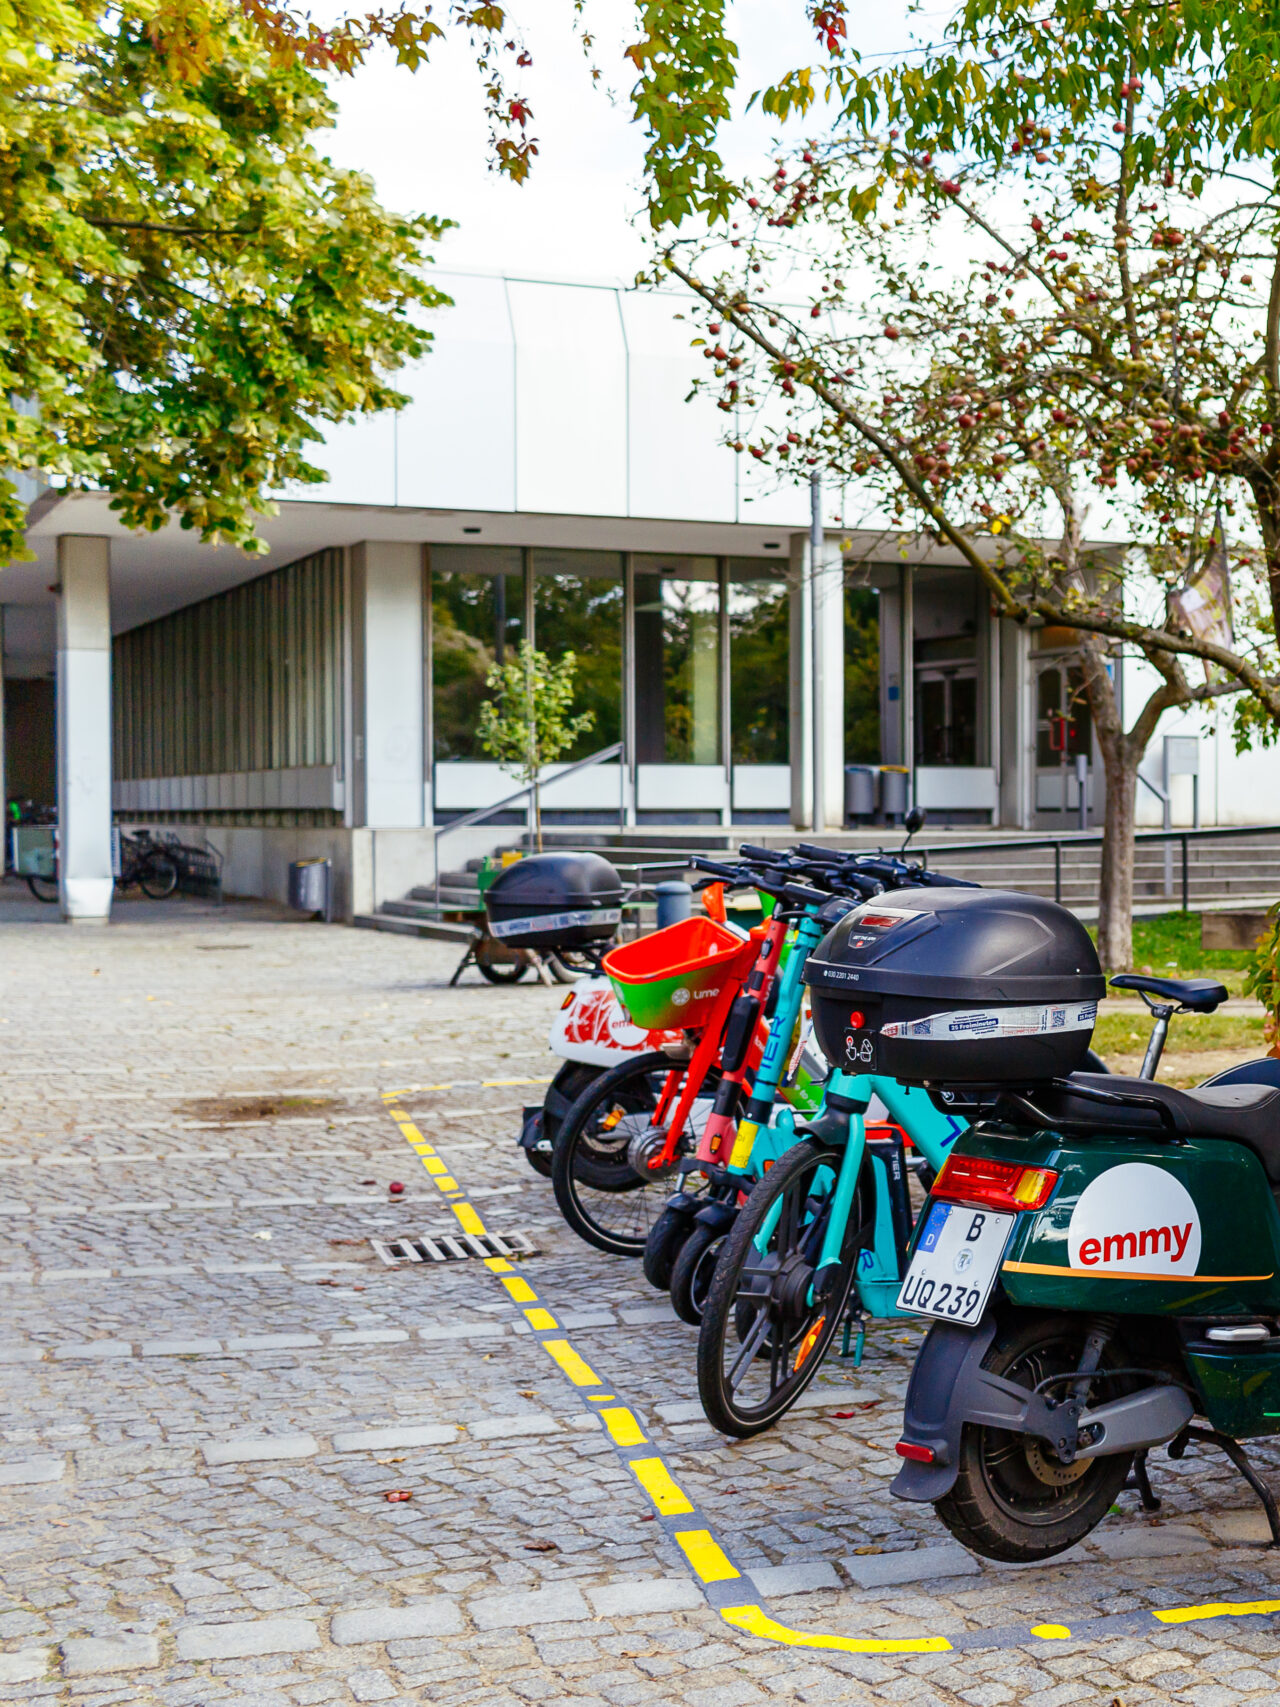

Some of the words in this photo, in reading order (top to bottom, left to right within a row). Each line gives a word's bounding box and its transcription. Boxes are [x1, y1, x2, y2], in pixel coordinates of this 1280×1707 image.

[891, 1151, 900, 1181] TIER
[925, 1234, 935, 1246] D
[966, 1214, 986, 1241] B
[1079, 1222, 1193, 1266] emmy
[933, 1283, 980, 1318] 239
